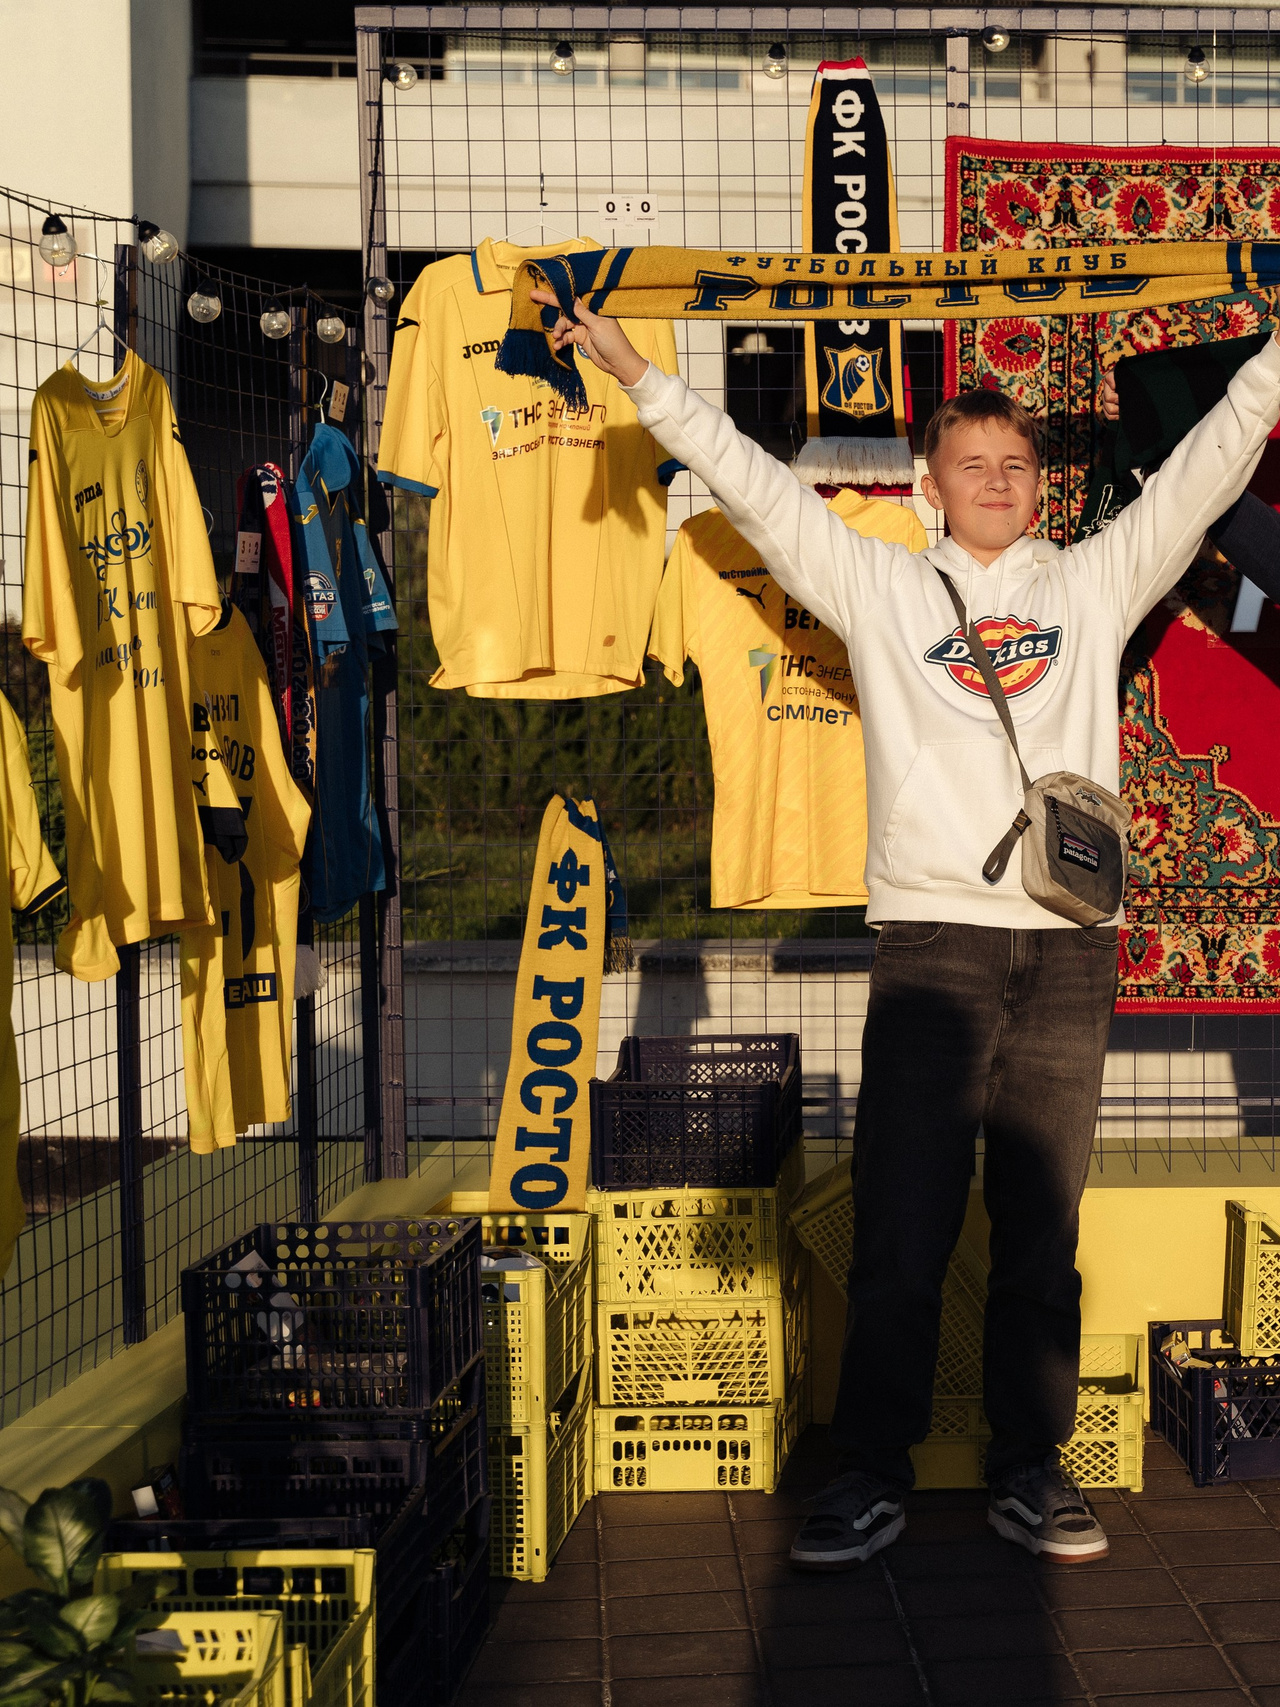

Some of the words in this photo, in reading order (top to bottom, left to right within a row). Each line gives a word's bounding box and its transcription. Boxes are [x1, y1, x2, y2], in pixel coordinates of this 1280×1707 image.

[831, 89, 866, 158] ФК
[606, 201, 616, 213] 0
[641, 201, 651, 213] 0
[727, 253, 998, 277] ФУТБОЛЬНЫЙ
[1027, 252, 1128, 274] КЛУБ
[462, 339, 500, 359] Jom
[941, 639, 1049, 667] Dkies
[1063, 847, 1098, 867] patagonia
[537, 847, 590, 951] ФК
